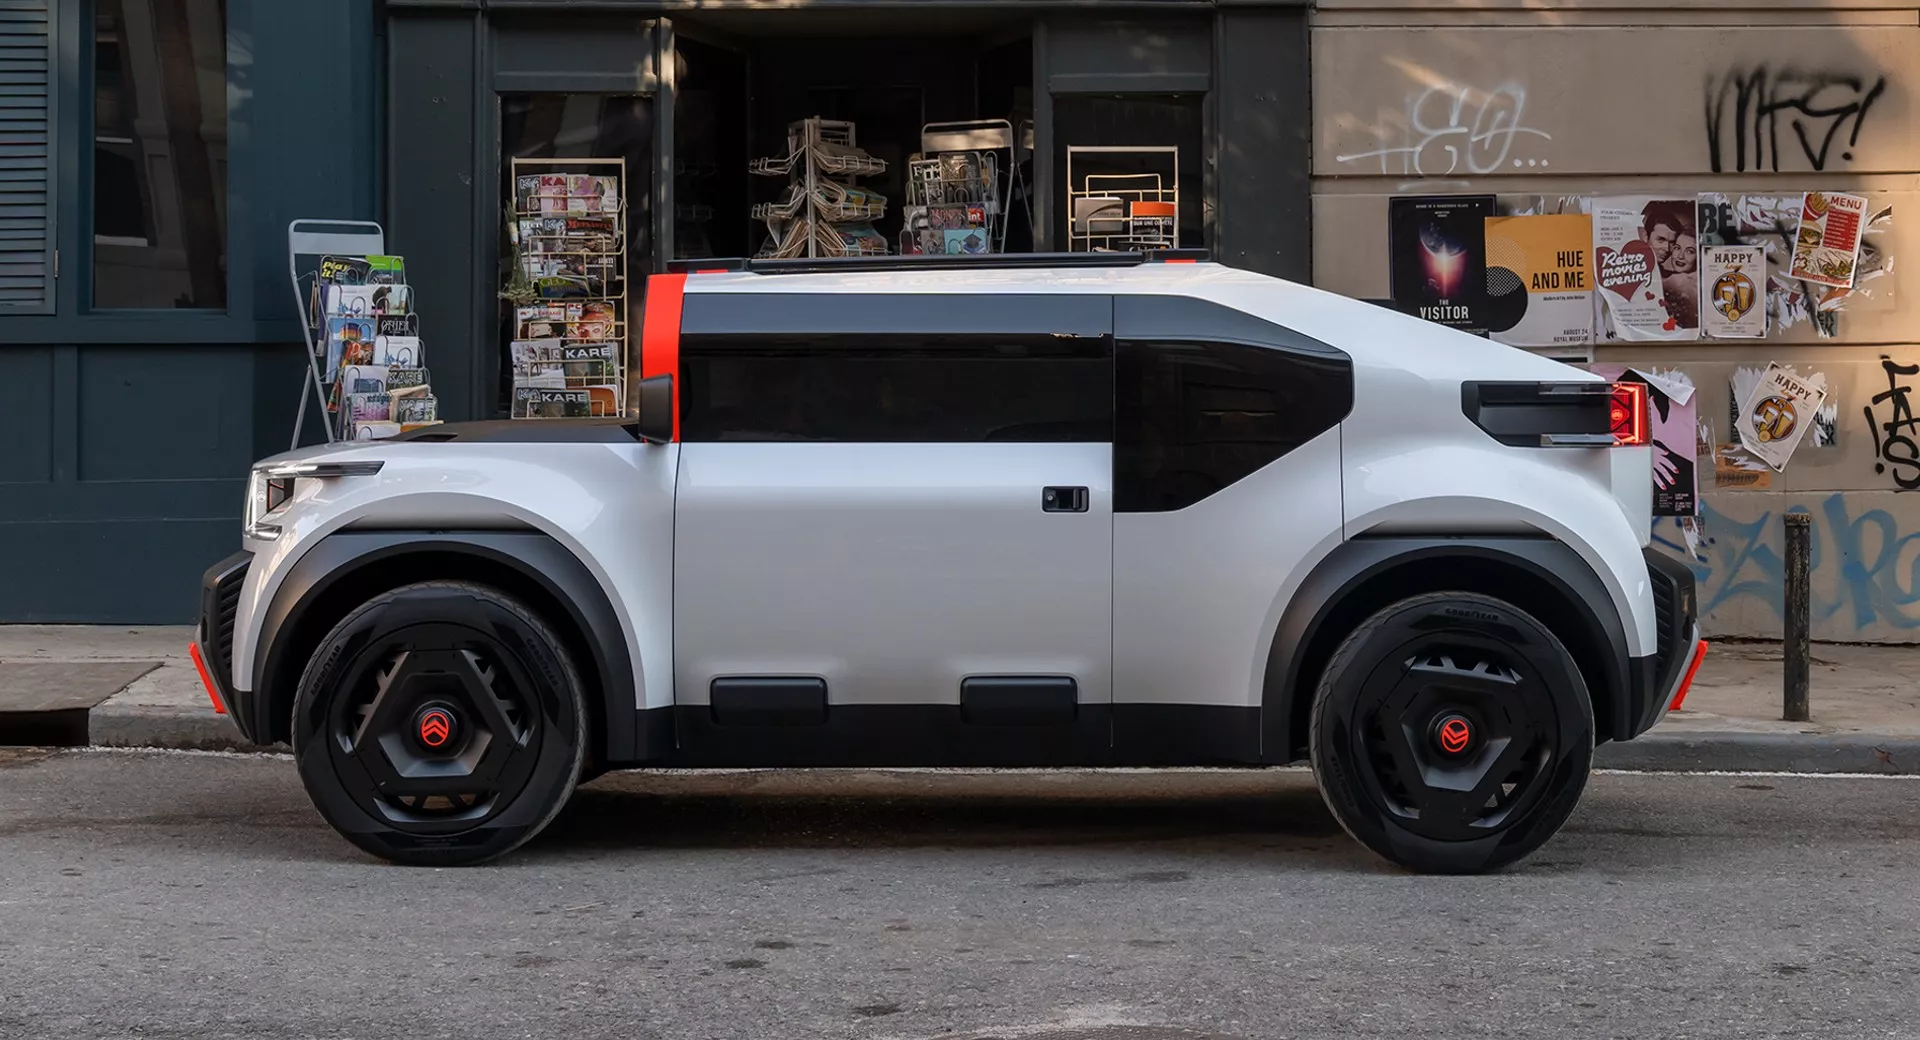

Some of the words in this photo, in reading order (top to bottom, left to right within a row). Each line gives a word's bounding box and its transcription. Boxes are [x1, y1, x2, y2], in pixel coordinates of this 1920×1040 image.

[1830, 196, 1862, 209] MENU
[1557, 251, 1584, 267] HUE
[1602, 252, 1644, 267] Retro
[1714, 253, 1753, 263] HAPPY
[1602, 262, 1647, 277] movies
[1532, 273, 1560, 289] AND
[1565, 272, 1585, 288] ME
[1603, 272, 1651, 288] evening
[1420, 306, 1469, 319] VISITOR
[565, 347, 610, 359] KARE
[1774, 374, 1811, 400] HAPPY
[542, 393, 586, 402] KARE
